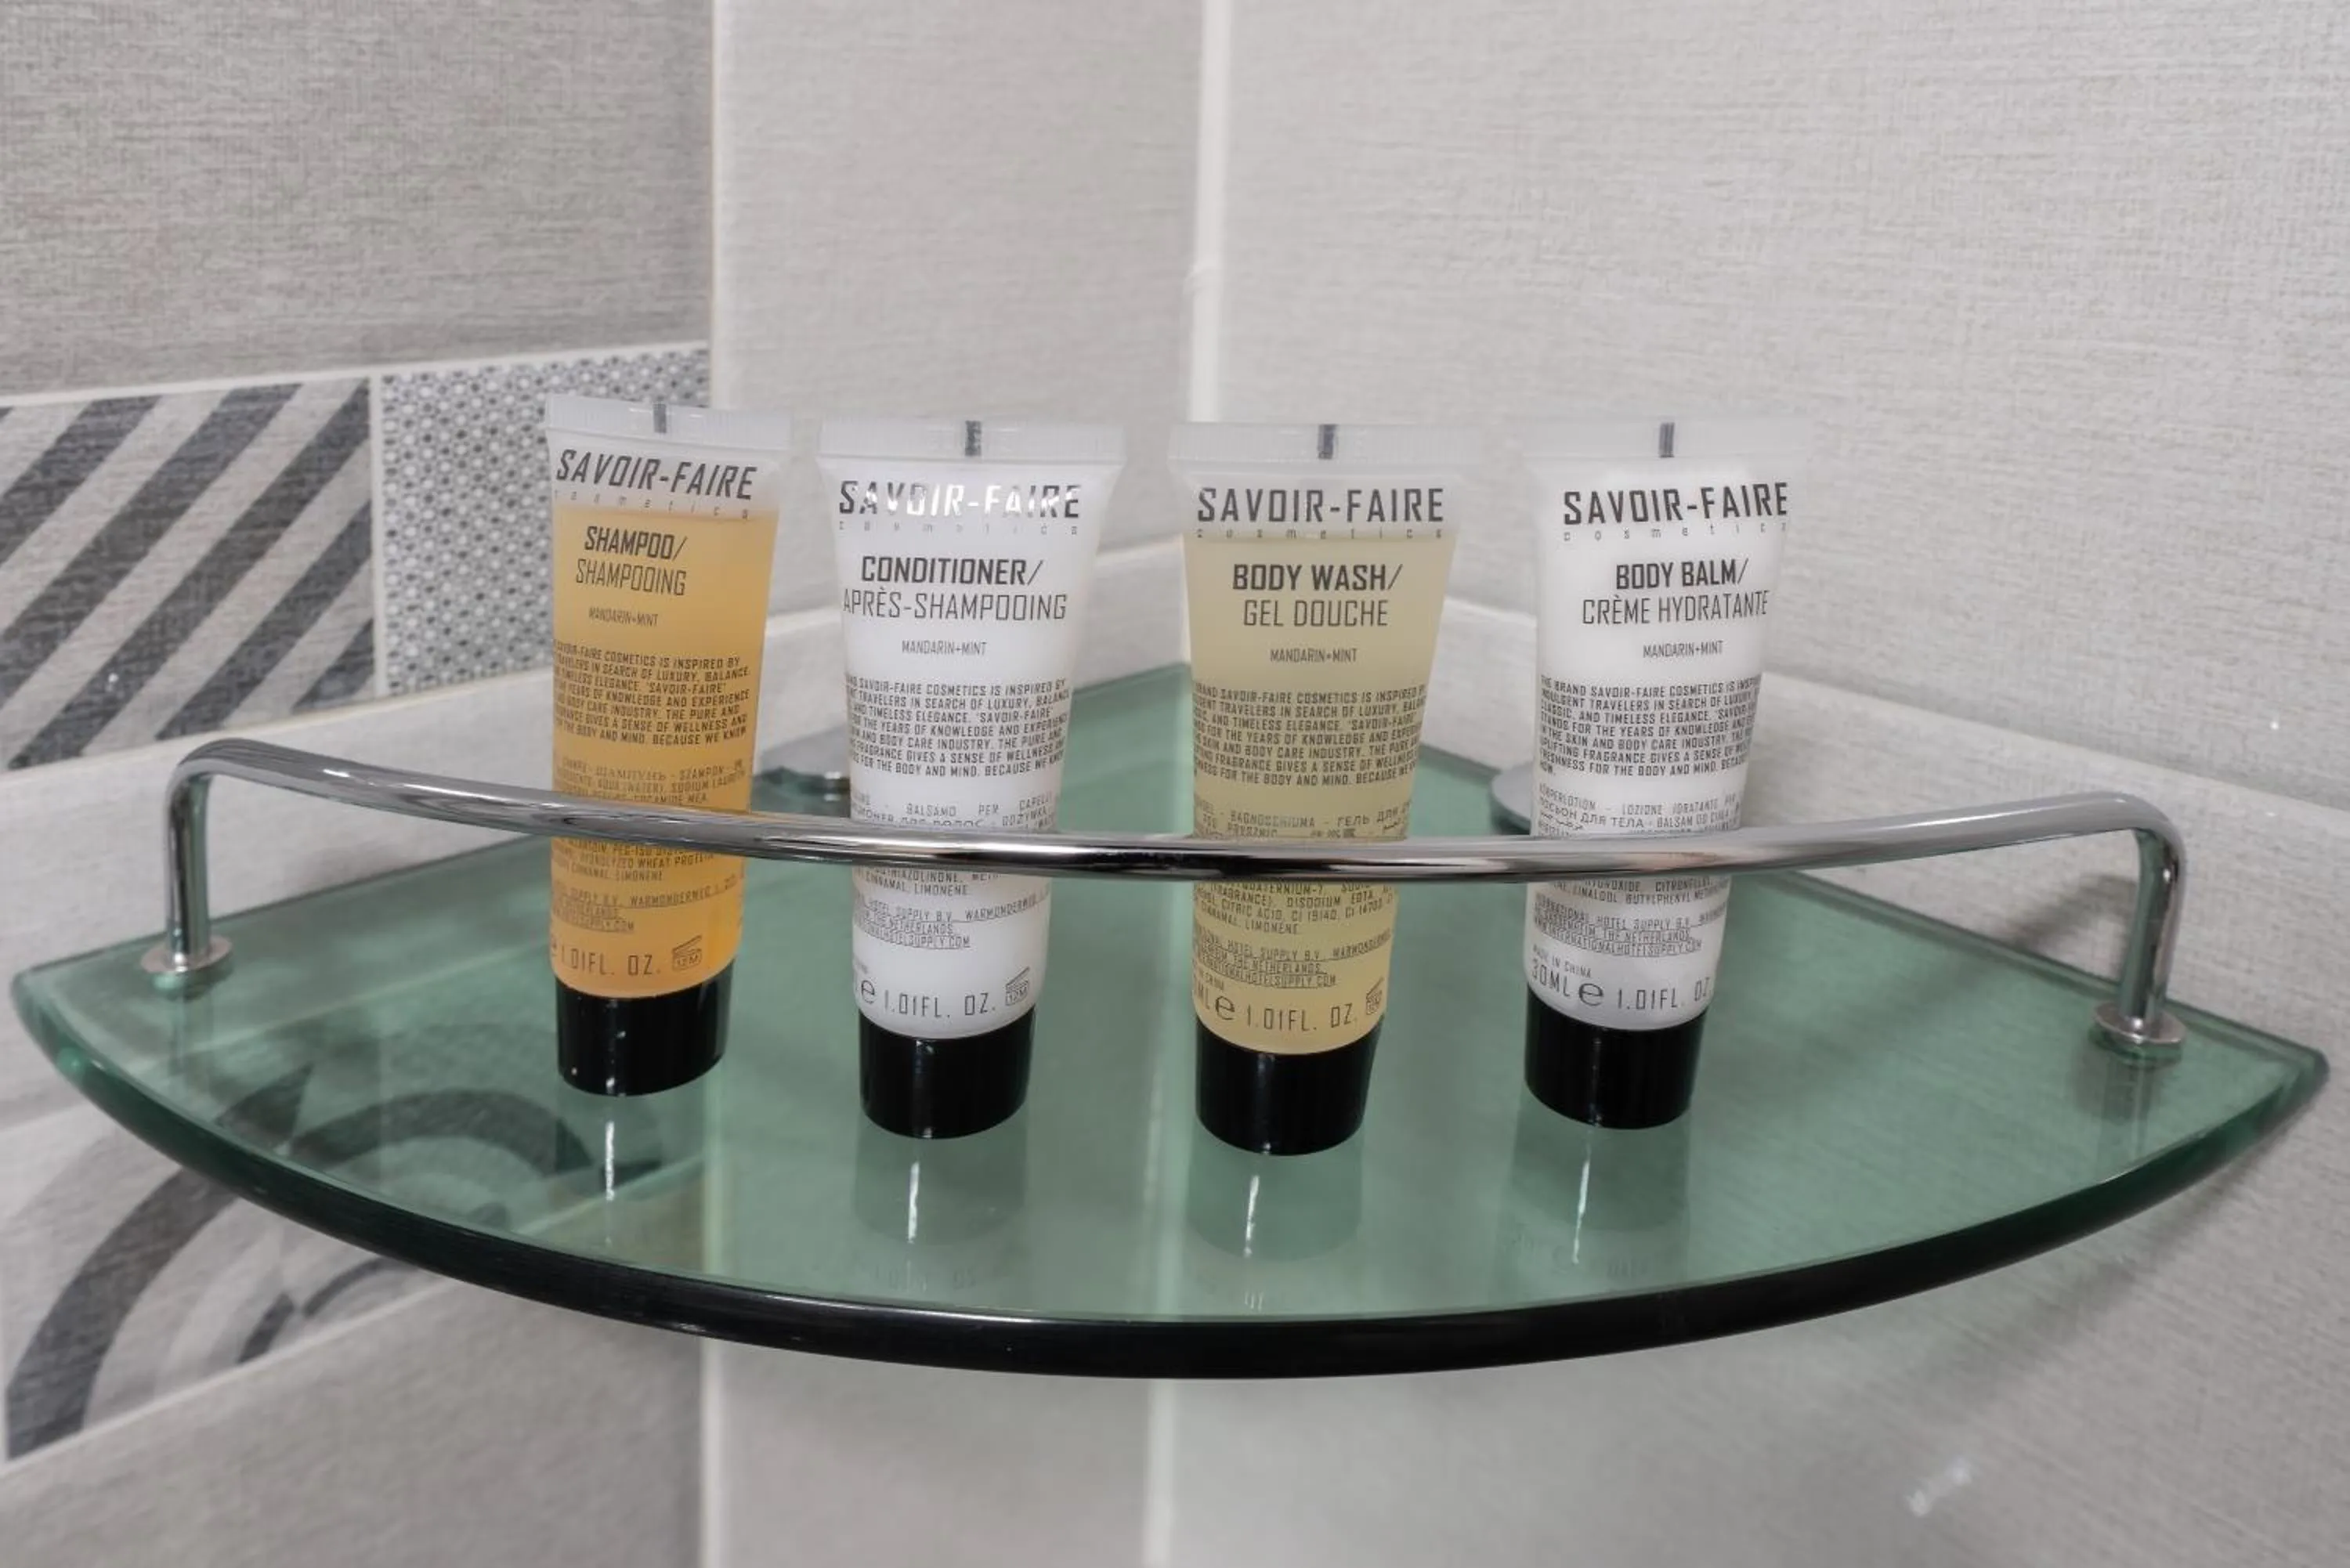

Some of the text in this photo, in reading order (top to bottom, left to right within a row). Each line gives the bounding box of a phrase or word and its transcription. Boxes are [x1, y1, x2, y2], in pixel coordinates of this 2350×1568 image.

[556, 449, 757, 500] SAVOIR-FAIRE
[839, 480, 1081, 518] SAVOIR-FAIRE
[1198, 487, 1444, 523] SAVOIR-FAIRE
[1564, 482, 1788, 526] SAVOIR-FAIRE
[584, 526, 688, 560] SHAMPOO/
[576, 558, 686, 595] SHAMPOOING
[861, 555, 1044, 586] CONDITIONER/
[1232, 563, 1403, 591] BODY WASH/
[1616, 558, 1749, 590] BODY BALM/
[842, 586, 1068, 622] APRÈS-SHAMPOOING
[1243, 599, 1389, 627] GEL DOUCHE
[1582, 590, 1770, 625] CRÈME HYDRATANTE
[902, 640, 988, 656] MANDARIN+MINT
[1270, 648, 1358, 663] MANDARIN+MINT
[1643, 640, 1724, 659] MANDARIN+MINT
[604, 651, 740, 669] COSMETICS IS INSPIRED BY
[602, 663, 638, 677] SEARCH
[642, 667, 653, 679] OF
[859, 677, 922, 695] SAVOIR-FAIRE
[927, 684, 986, 696] COSMETICS
[990, 685, 1001, 696] IS
[1006, 681, 1052, 696] INSPIRED
[1220, 686, 1417, 704] SAVOIR-FAIRE COSMETICS IS INSPIRED
[1554, 680, 1585, 696] BRAND
[1591, 685, 1665, 699] SAVOIR-FAIRE
[1669, 682, 1723, 697] COSMETICS
[606, 688, 750, 707] KNOWLEDGE AND EXPERIENCE
[859, 689, 982, 710] TRAVELERS IN SEARCH OF
[1590, 695, 1721, 712] TRAVELERS IN SEARCH OF
[666, 704, 739, 720] THE PURE AND
[869, 706, 912, 721] TIMELESS
[1220, 701, 1354, 718] TRAVELERS IN SEARCH OF
[1579, 710, 1655, 724] AND TIMELESS
[622, 719, 727, 733] SENSE OF WELLNESS
[881, 721, 910, 734] YEARS
[914, 724, 926, 735] OF
[931, 725, 994, 738] KNOWLEDGE
[999, 724, 1019, 736] AND
[1213, 714, 1282, 731] AND TIMELESS
[1572, 720, 1729, 737] FOR THE YEARS OF KNOWLEDGE
[599, 730, 718, 745] AND BECAUSE WE
[880, 734, 903, 746] BODY
[908, 737, 933, 750] CARE
[998, 737, 1018, 750] THE
[1021, 732, 1045, 746] PURE
[1226, 729, 1242, 742] THE
[1247, 732, 1280, 744] YEARS
[1285, 733, 1297, 745] OF
[1302, 732, 1365, 746] KNOWLEDGE
[1369, 731, 1388, 742] AND
[1566, 732, 1677, 751] SKIN AND BODY CARE
[907, 743, 1054, 764] GIVES SENSE OF WELLNESS
[1223, 742, 1242, 754] AND
[1245, 745, 1272, 757] BODY
[1278, 746, 1303, 759] CARE
[1369, 744, 1386, 756] THE
[1583, 747, 1721, 764] FRAGRANCE GIVES A SENSE
[877, 758, 1032, 777] THE BODY AND BECAUSE
[1215, 753, 1271, 771] FRAGRANCE
[1276, 760, 1307, 773] GIVES
[1311, 761, 1317, 772] A
[1323, 761, 1355, 772] SENSE
[1359, 758, 1372, 771] OF
[1589, 762, 1609, 775] FOR
[1614, 765, 1633, 776] THE
[1638, 764, 1666, 777] BODY
[1670, 764, 1690, 776] AND
[1220, 767, 1396, 786] FOR THE BODY AND BECAUSE
[906, 802, 1000, 817] BALSAMO PER
[1611, 816, 1644, 829] ТЕЛА
[1657, 815, 1693, 828] BALSAM
[914, 884, 968, 897] LIMONENE
[1221, 898, 1302, 923] CITRIC CI
[1286, 895, 1341, 909] DISODIUM
[1246, 919, 1300, 935] LIMONENE
[627, 954, 661, 977] OZ.
[884, 989, 951, 1019] 1.01FL.
[964, 992, 996, 1017] OZ.
[1246, 1004, 1318, 1032] 1.01FL.
